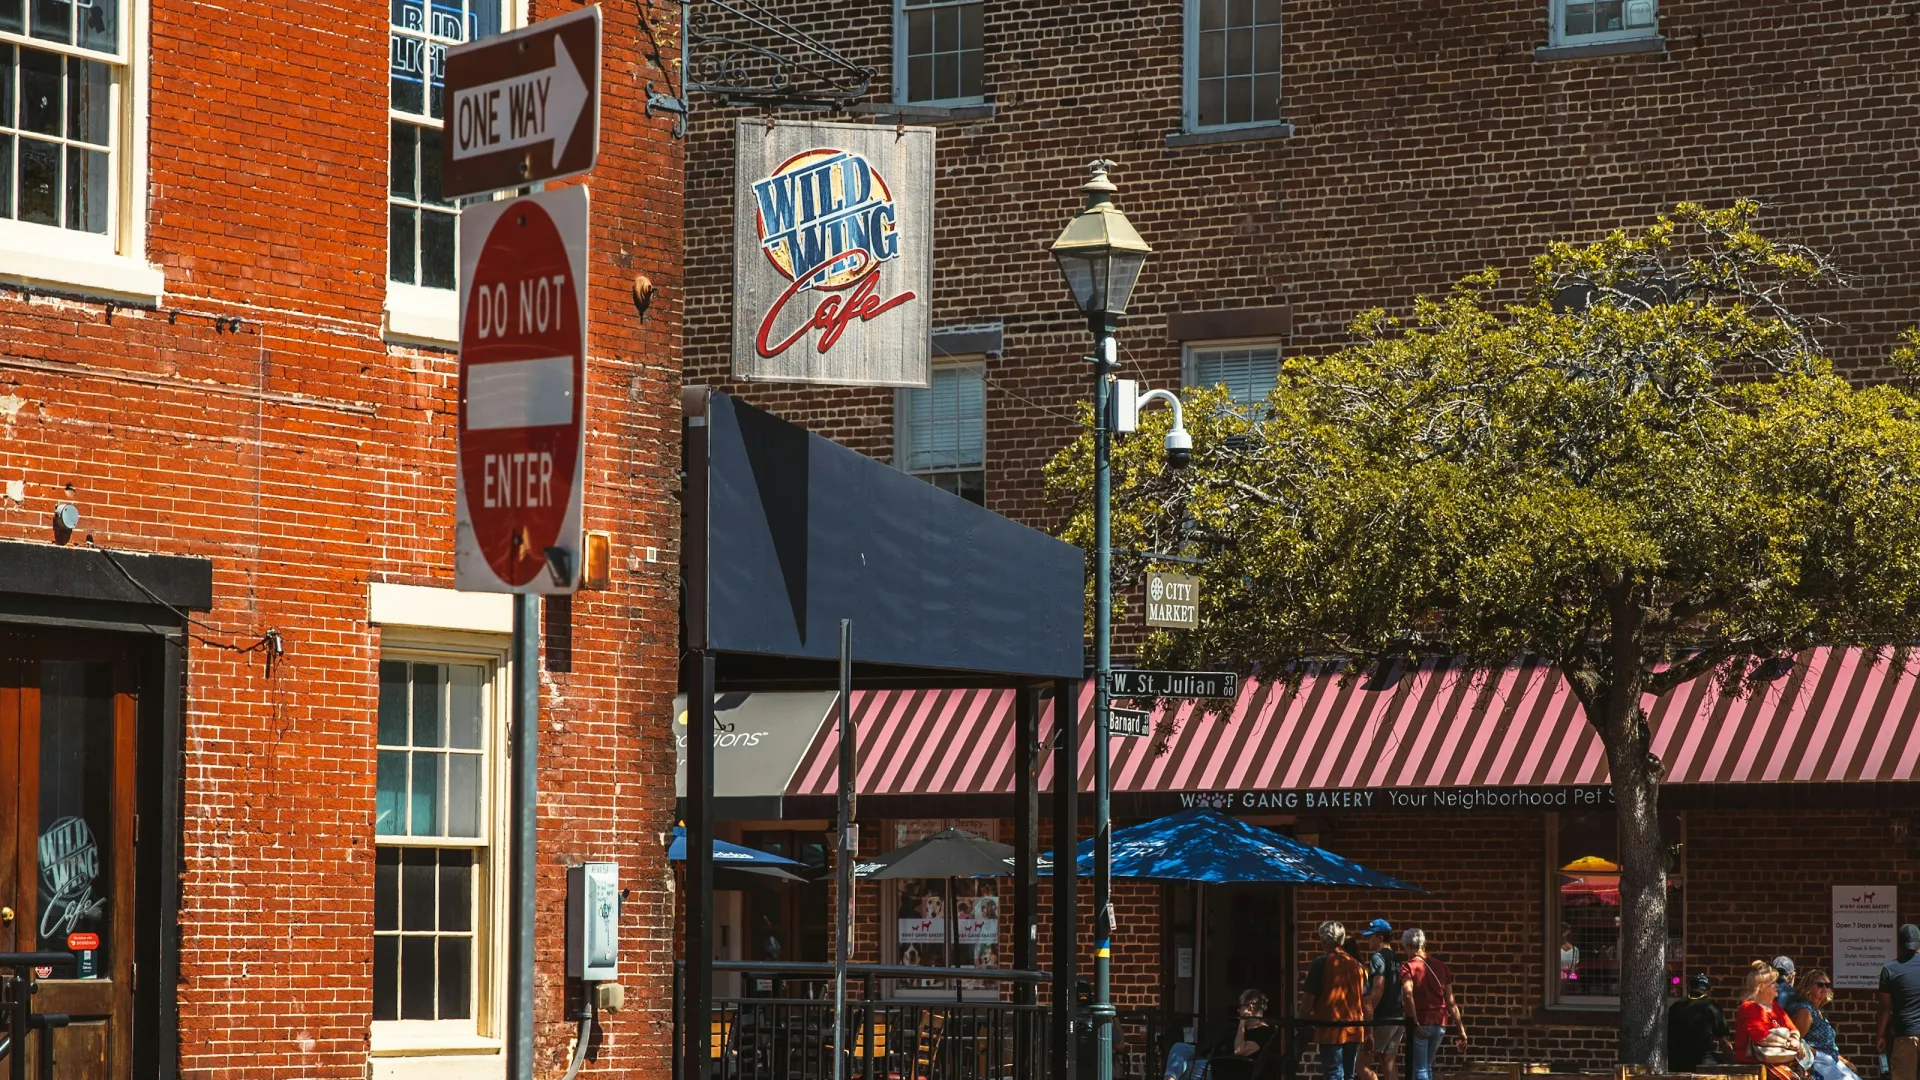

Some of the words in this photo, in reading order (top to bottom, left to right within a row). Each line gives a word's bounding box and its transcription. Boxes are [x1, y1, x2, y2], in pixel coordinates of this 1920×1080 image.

[391, 36, 448, 78] LIGH
[458, 90, 501, 151] ONE
[509, 75, 551, 141] WAY
[754, 156, 872, 236] WILD
[783, 203, 900, 290] WING
[478, 281, 508, 339] DO
[519, 274, 565, 335] NOT
[756, 249, 917, 358] Cafe
[483, 451, 553, 508] ENTER
[1149, 603, 1195, 622] MARKET
[1165, 582, 1192, 601] CITY
[1114, 674, 1131, 693] W.
[1162, 675, 1215, 694] Julian
[1223, 686, 1234, 697] 00
[1224, 675, 1235, 686] ST
[1109, 711, 1140, 733] Barnard
[1242, 792, 1298, 808] GANG
[1306, 791, 1373, 808] BAKERY
[1388, 790, 1427, 806] Your
[1433, 789, 1566, 810] Neighborhood
[1574, 788, 1602, 804] Pet
[38, 818, 88, 867] WILD
[52, 846, 99, 897] WING
[40, 872, 107, 939] Cafe
